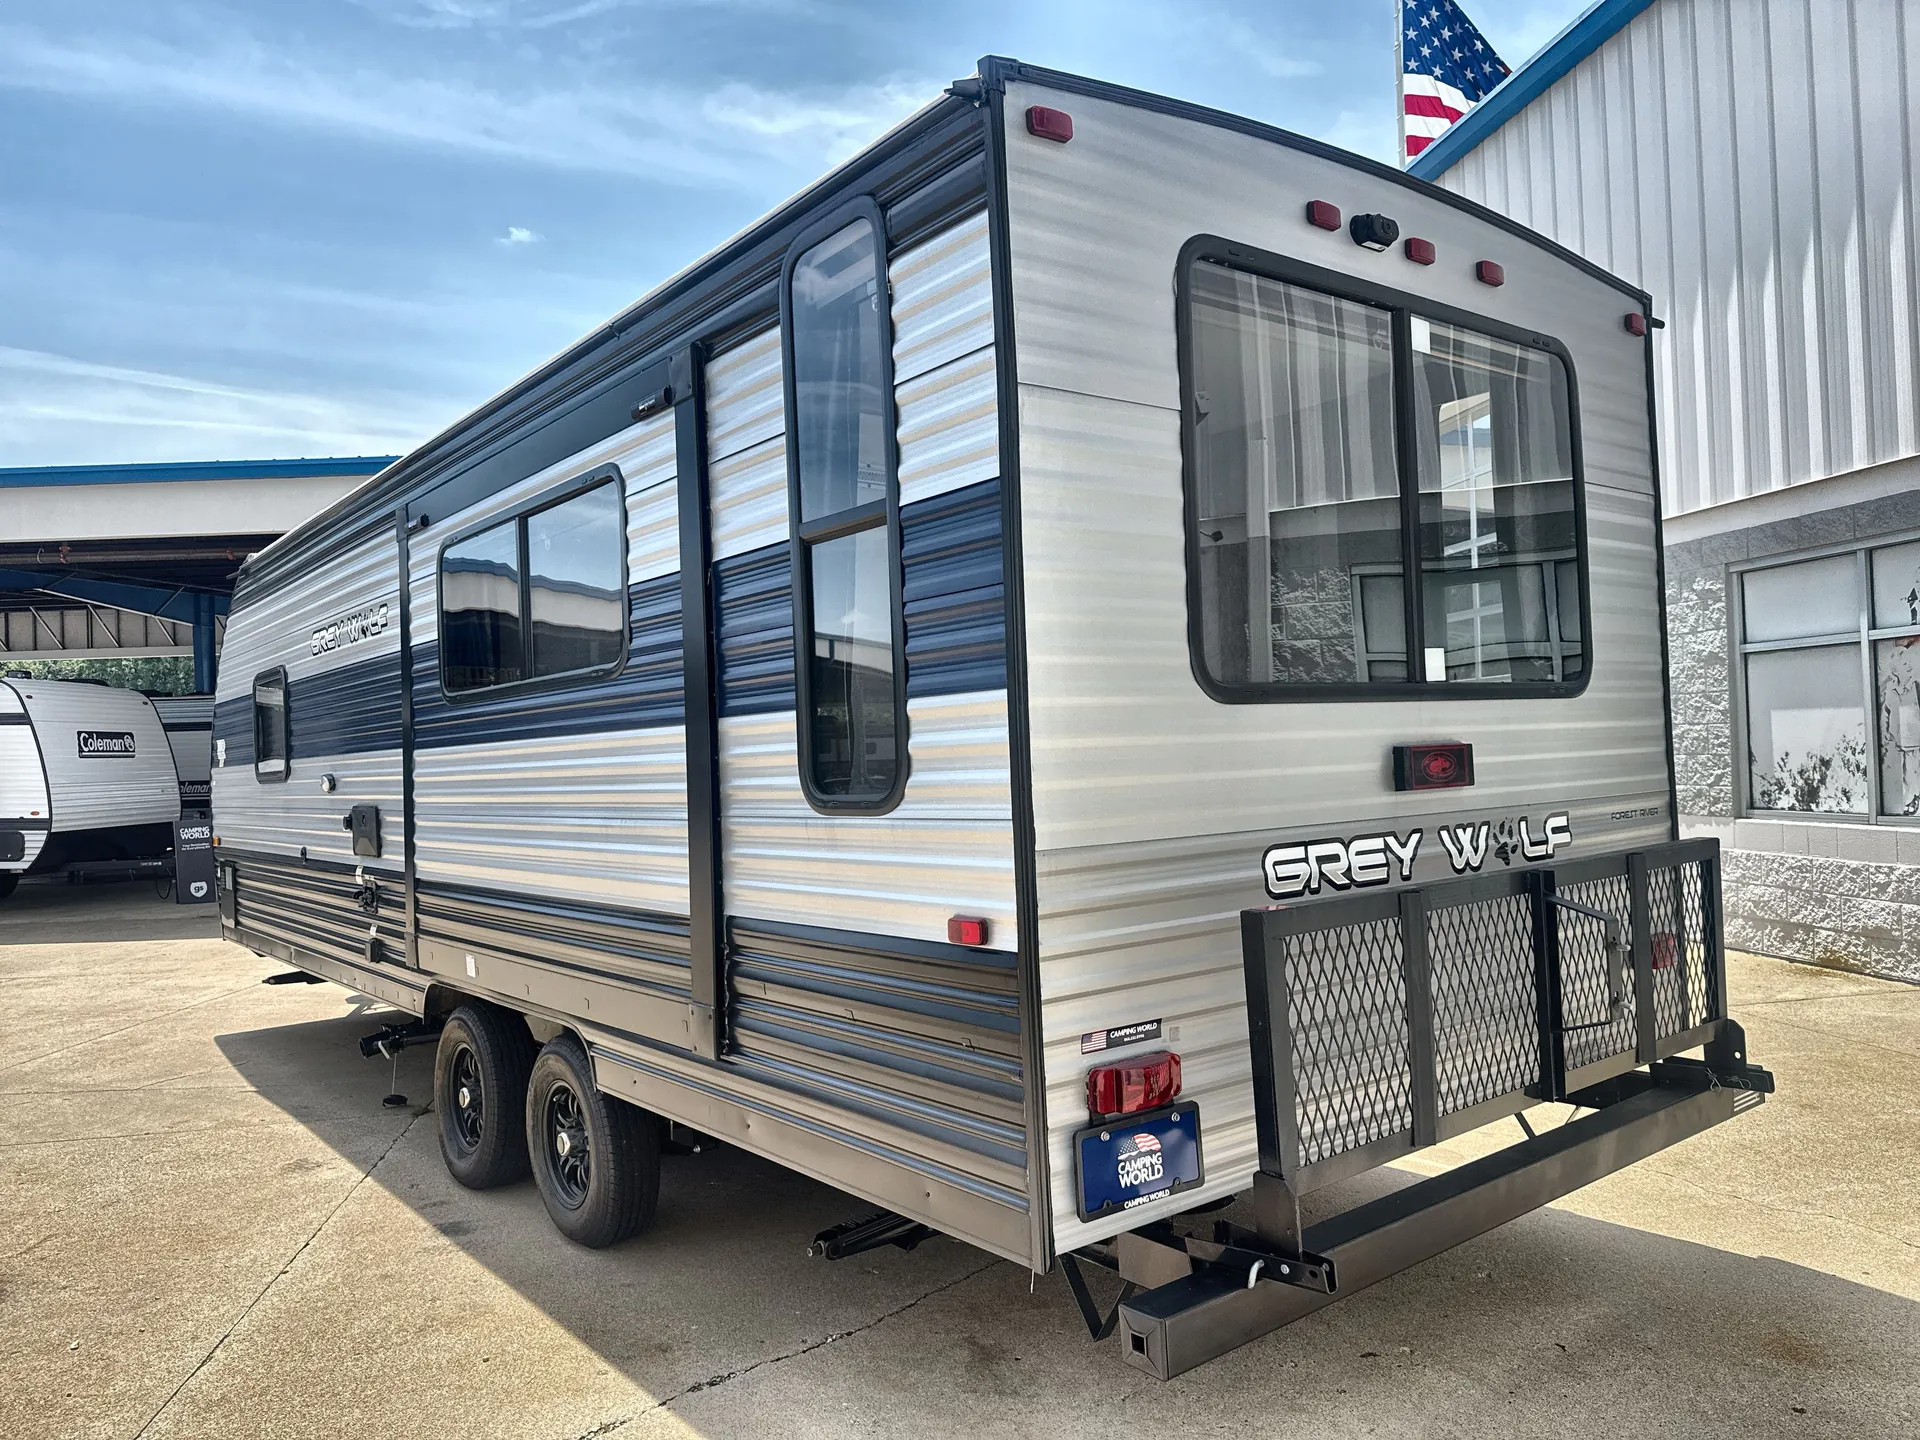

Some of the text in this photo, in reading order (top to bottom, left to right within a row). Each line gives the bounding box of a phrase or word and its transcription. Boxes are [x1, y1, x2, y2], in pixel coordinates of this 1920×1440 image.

[310, 619, 344, 656] GREY
[80, 732, 125, 752] Coleman
[180, 781, 210, 793] olema
[1610, 807, 1659, 820] FOREST RIVER
[179, 826, 210, 834] CAMPING
[180, 831, 210, 840] WORLD
[1261, 828, 1423, 900] GREY
[1110, 1026, 1137, 1039] CAMPING
[1136, 1022, 1158, 1033] WORLD
[1118, 1152, 1163, 1175] CAMPING
[1118, 1164, 1164, 1189] WORLD
[1124, 1189, 1170, 1209] CAMPING WORLD
